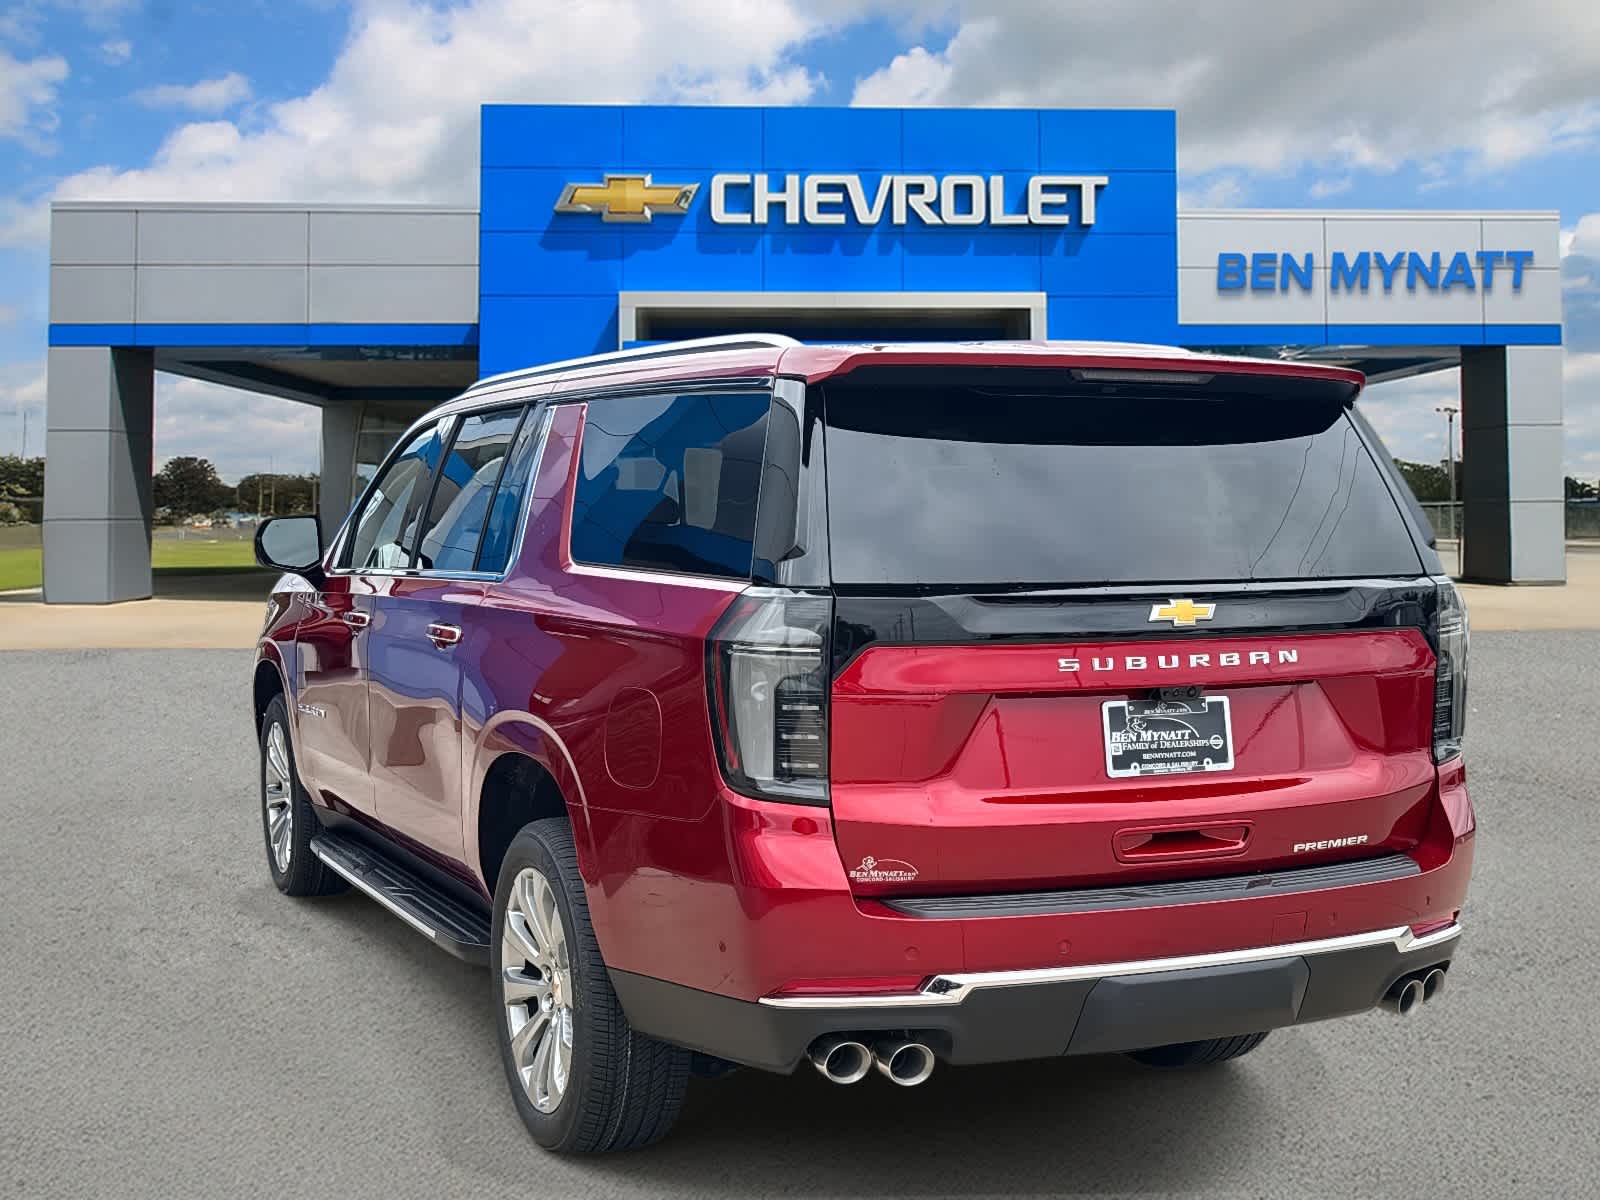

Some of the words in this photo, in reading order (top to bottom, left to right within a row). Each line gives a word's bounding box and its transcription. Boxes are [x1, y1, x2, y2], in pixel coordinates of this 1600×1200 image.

[710, 173, 1109, 227] CHEVROLET
[1217, 252, 1313, 290] BEN
[1330, 250, 1534, 290] MYNATT
[1057, 649, 1299, 672] SUBURBAN
[1111, 731, 1138, 742] BEN
[1140, 730, 1191, 741] MYNATT
[1122, 742, 1149, 750] FAMILY
[1160, 739, 1209, 748] DEALERSHIPS
[1142, 751, 1197, 759] BENMYNATT.COM
[1293, 834, 1369, 853] PREMIER
[849, 870, 868, 878] BEN
